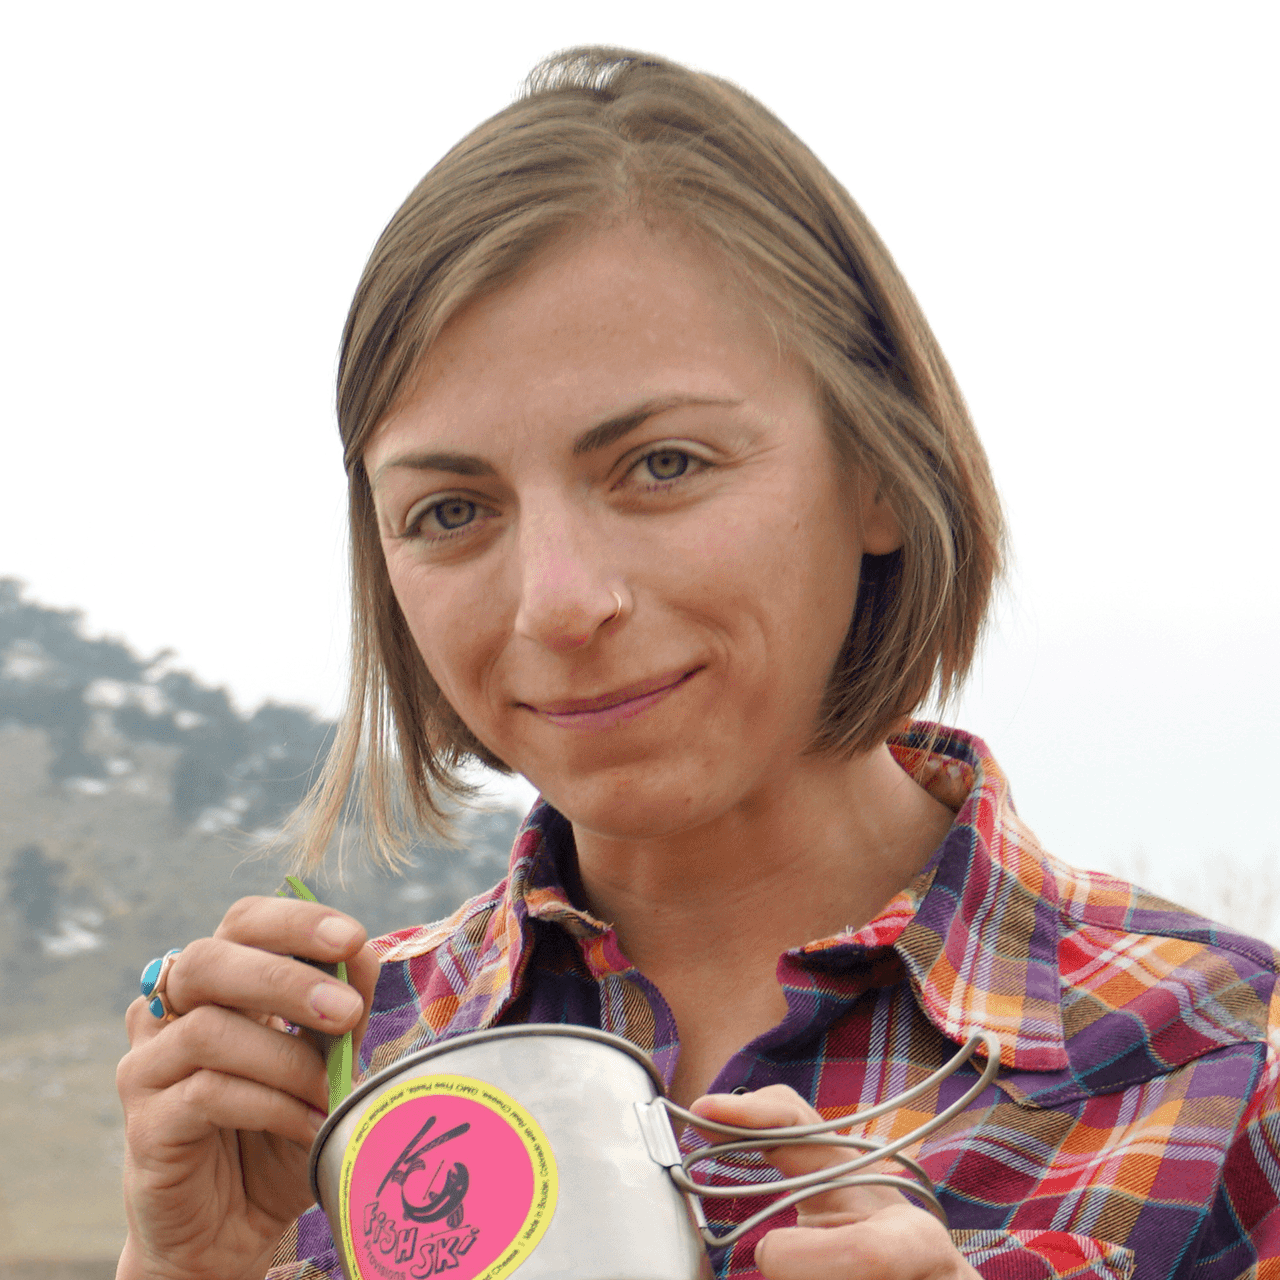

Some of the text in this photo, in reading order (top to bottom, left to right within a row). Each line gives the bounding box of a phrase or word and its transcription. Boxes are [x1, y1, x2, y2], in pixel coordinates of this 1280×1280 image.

[434, 1082, 454, 1091] Free
[508, 1110, 528, 1130] Real
[522, 1126, 538, 1145] with
[531, 1141, 549, 1179] Colorado
[533, 1210, 545, 1219] in
[521, 1218, 541, 1241] Made
[490, 1247, 521, 1277] Cheese
